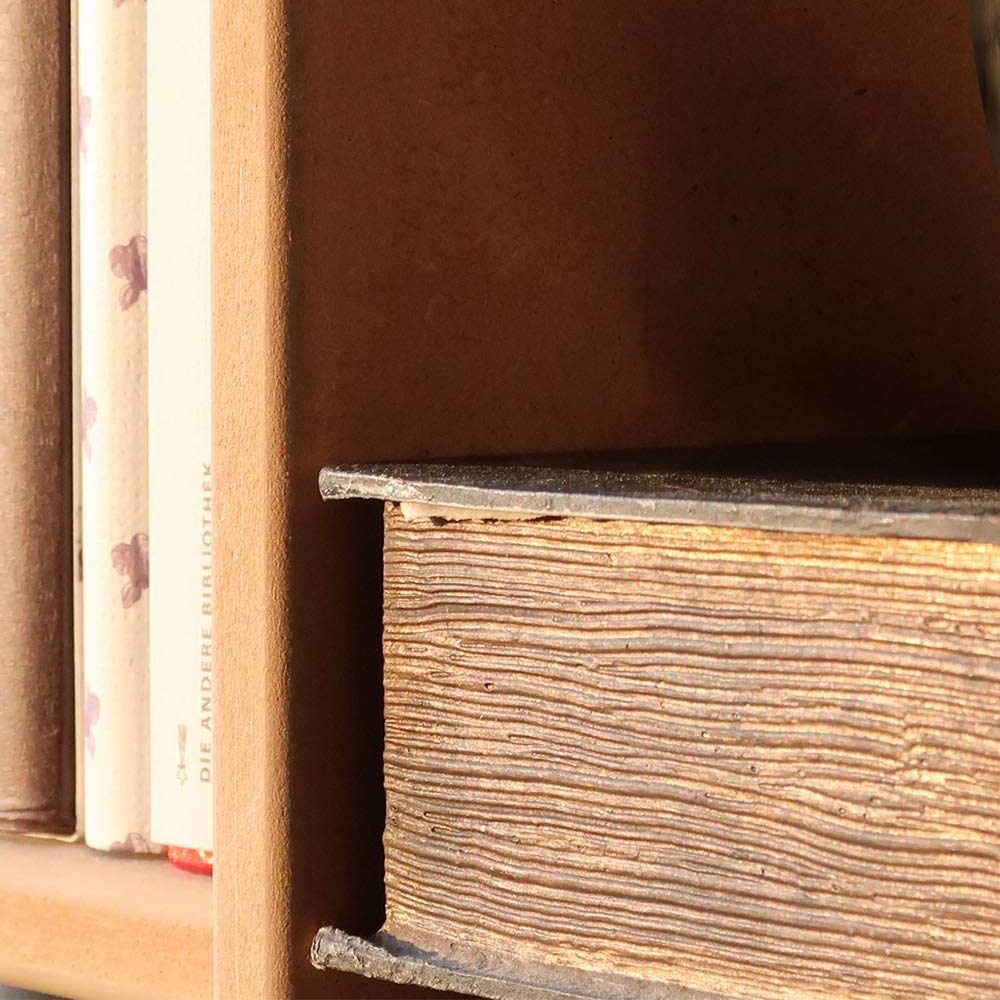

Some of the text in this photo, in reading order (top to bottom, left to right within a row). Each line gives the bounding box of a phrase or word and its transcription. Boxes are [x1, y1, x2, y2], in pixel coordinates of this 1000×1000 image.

[199, 462, 212, 784] DIE ANDERE BIBLIOTHEK
